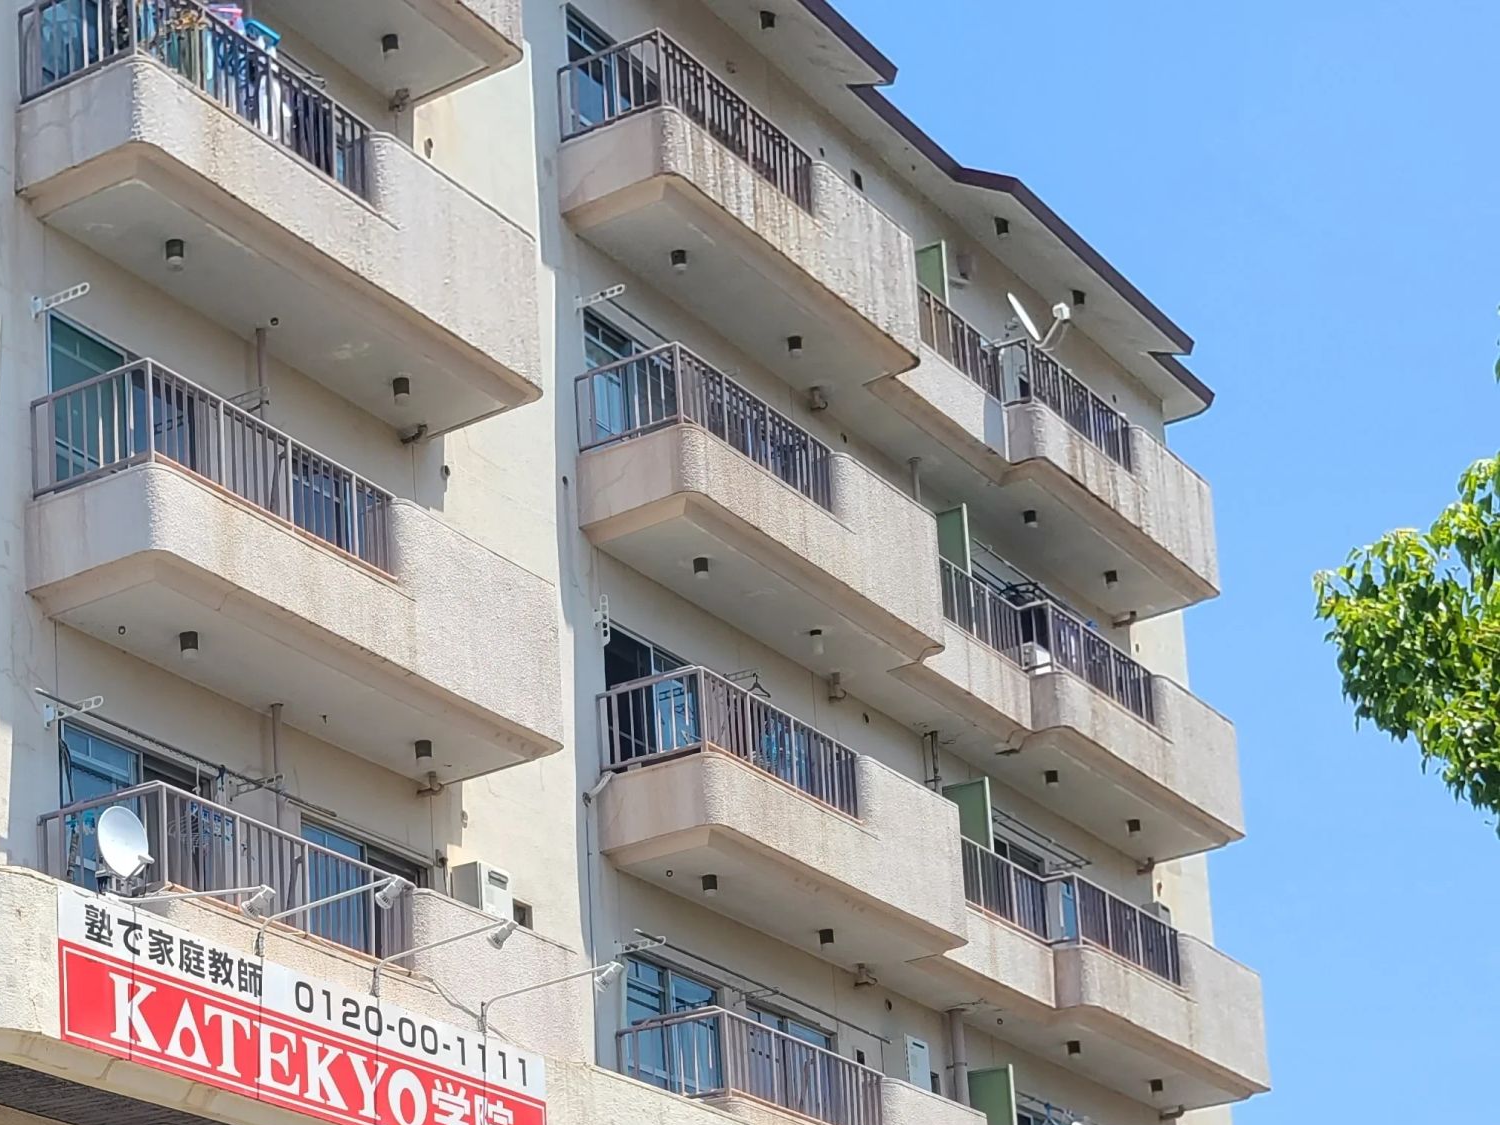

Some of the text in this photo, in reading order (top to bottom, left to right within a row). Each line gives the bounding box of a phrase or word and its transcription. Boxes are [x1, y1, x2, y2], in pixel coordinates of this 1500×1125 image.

[84, 904, 262, 998] 塾で家庭教師
[295, 980, 529, 1088] 0120-00-1111
